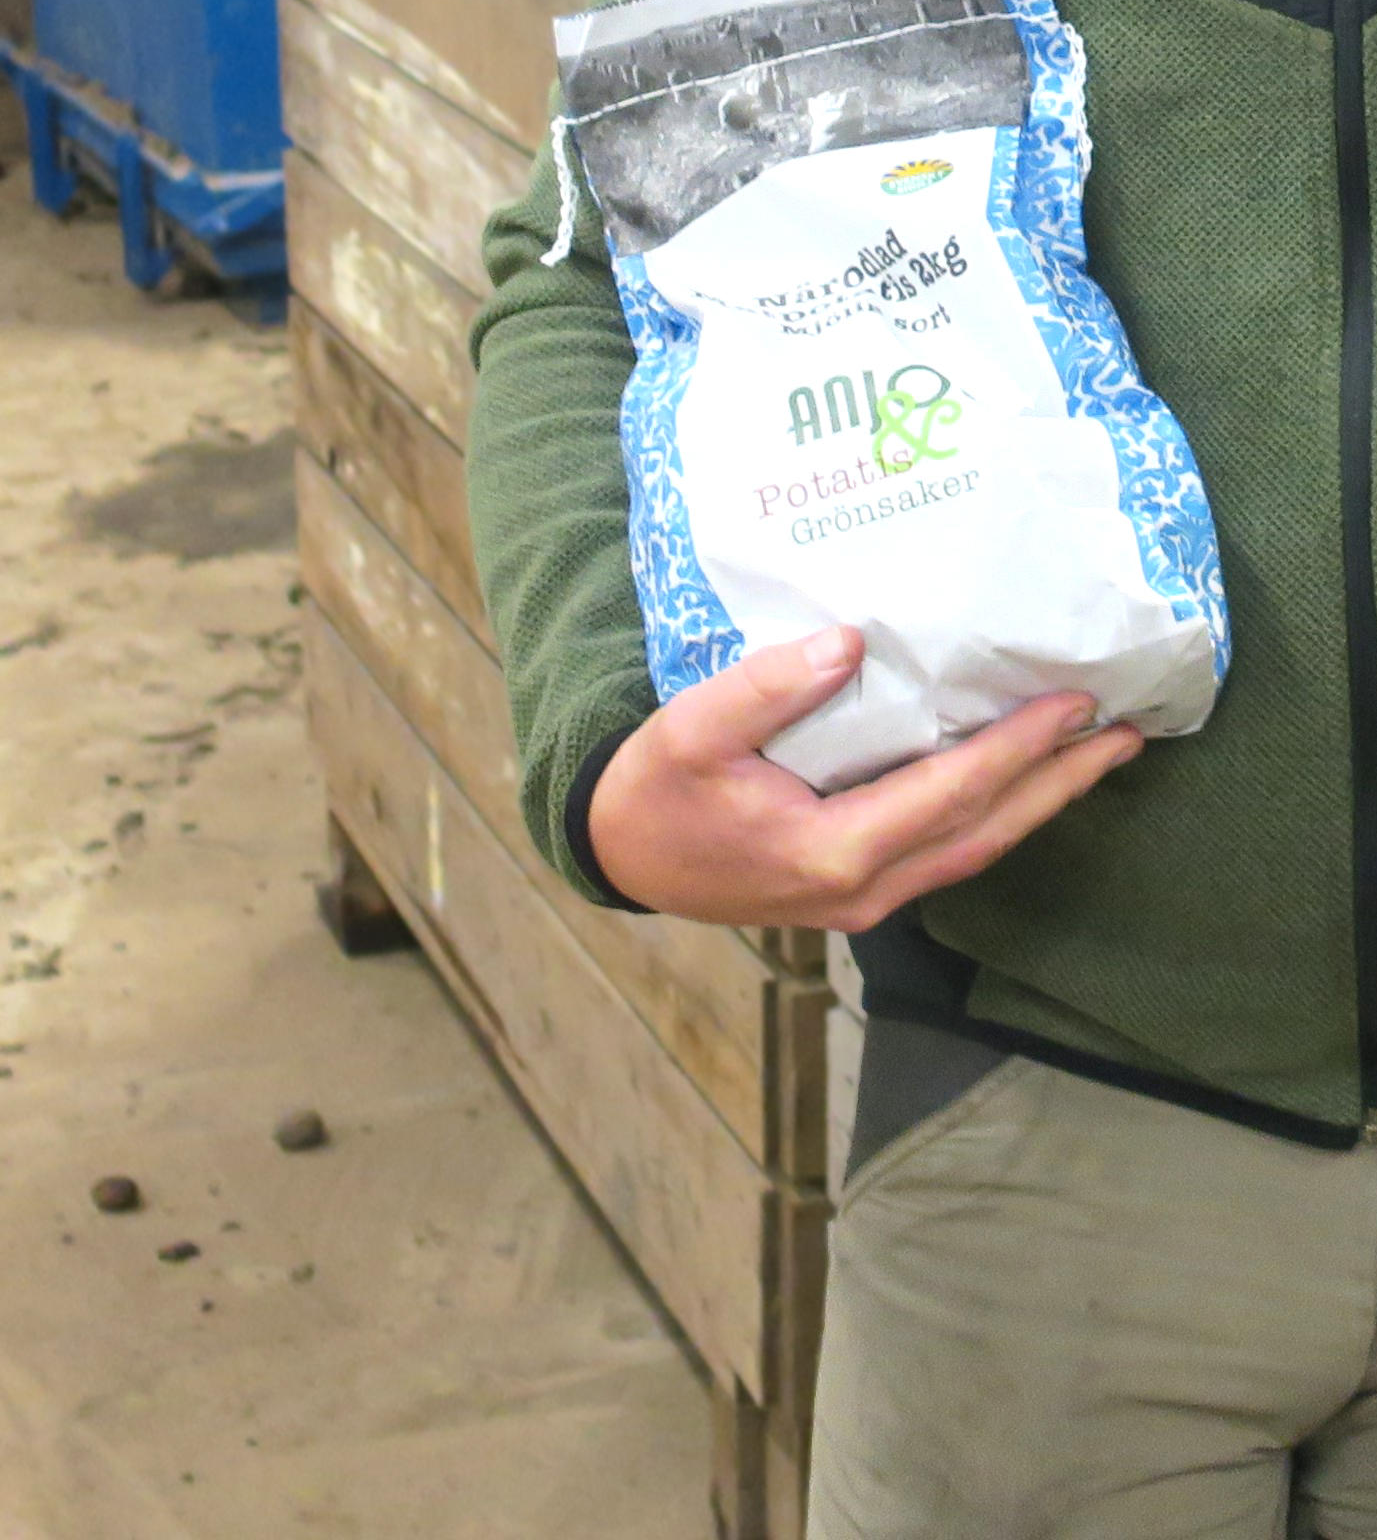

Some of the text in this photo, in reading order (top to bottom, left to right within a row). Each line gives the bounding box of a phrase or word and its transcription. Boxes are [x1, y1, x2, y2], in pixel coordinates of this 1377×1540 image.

[757, 227, 908, 308] Närodlad
[907, 234, 968, 288] 2kg
[893, 302, 952, 334] sort
[753, 448, 914, 521] Potatis
[790, 468, 980, 545] Grönsaker
